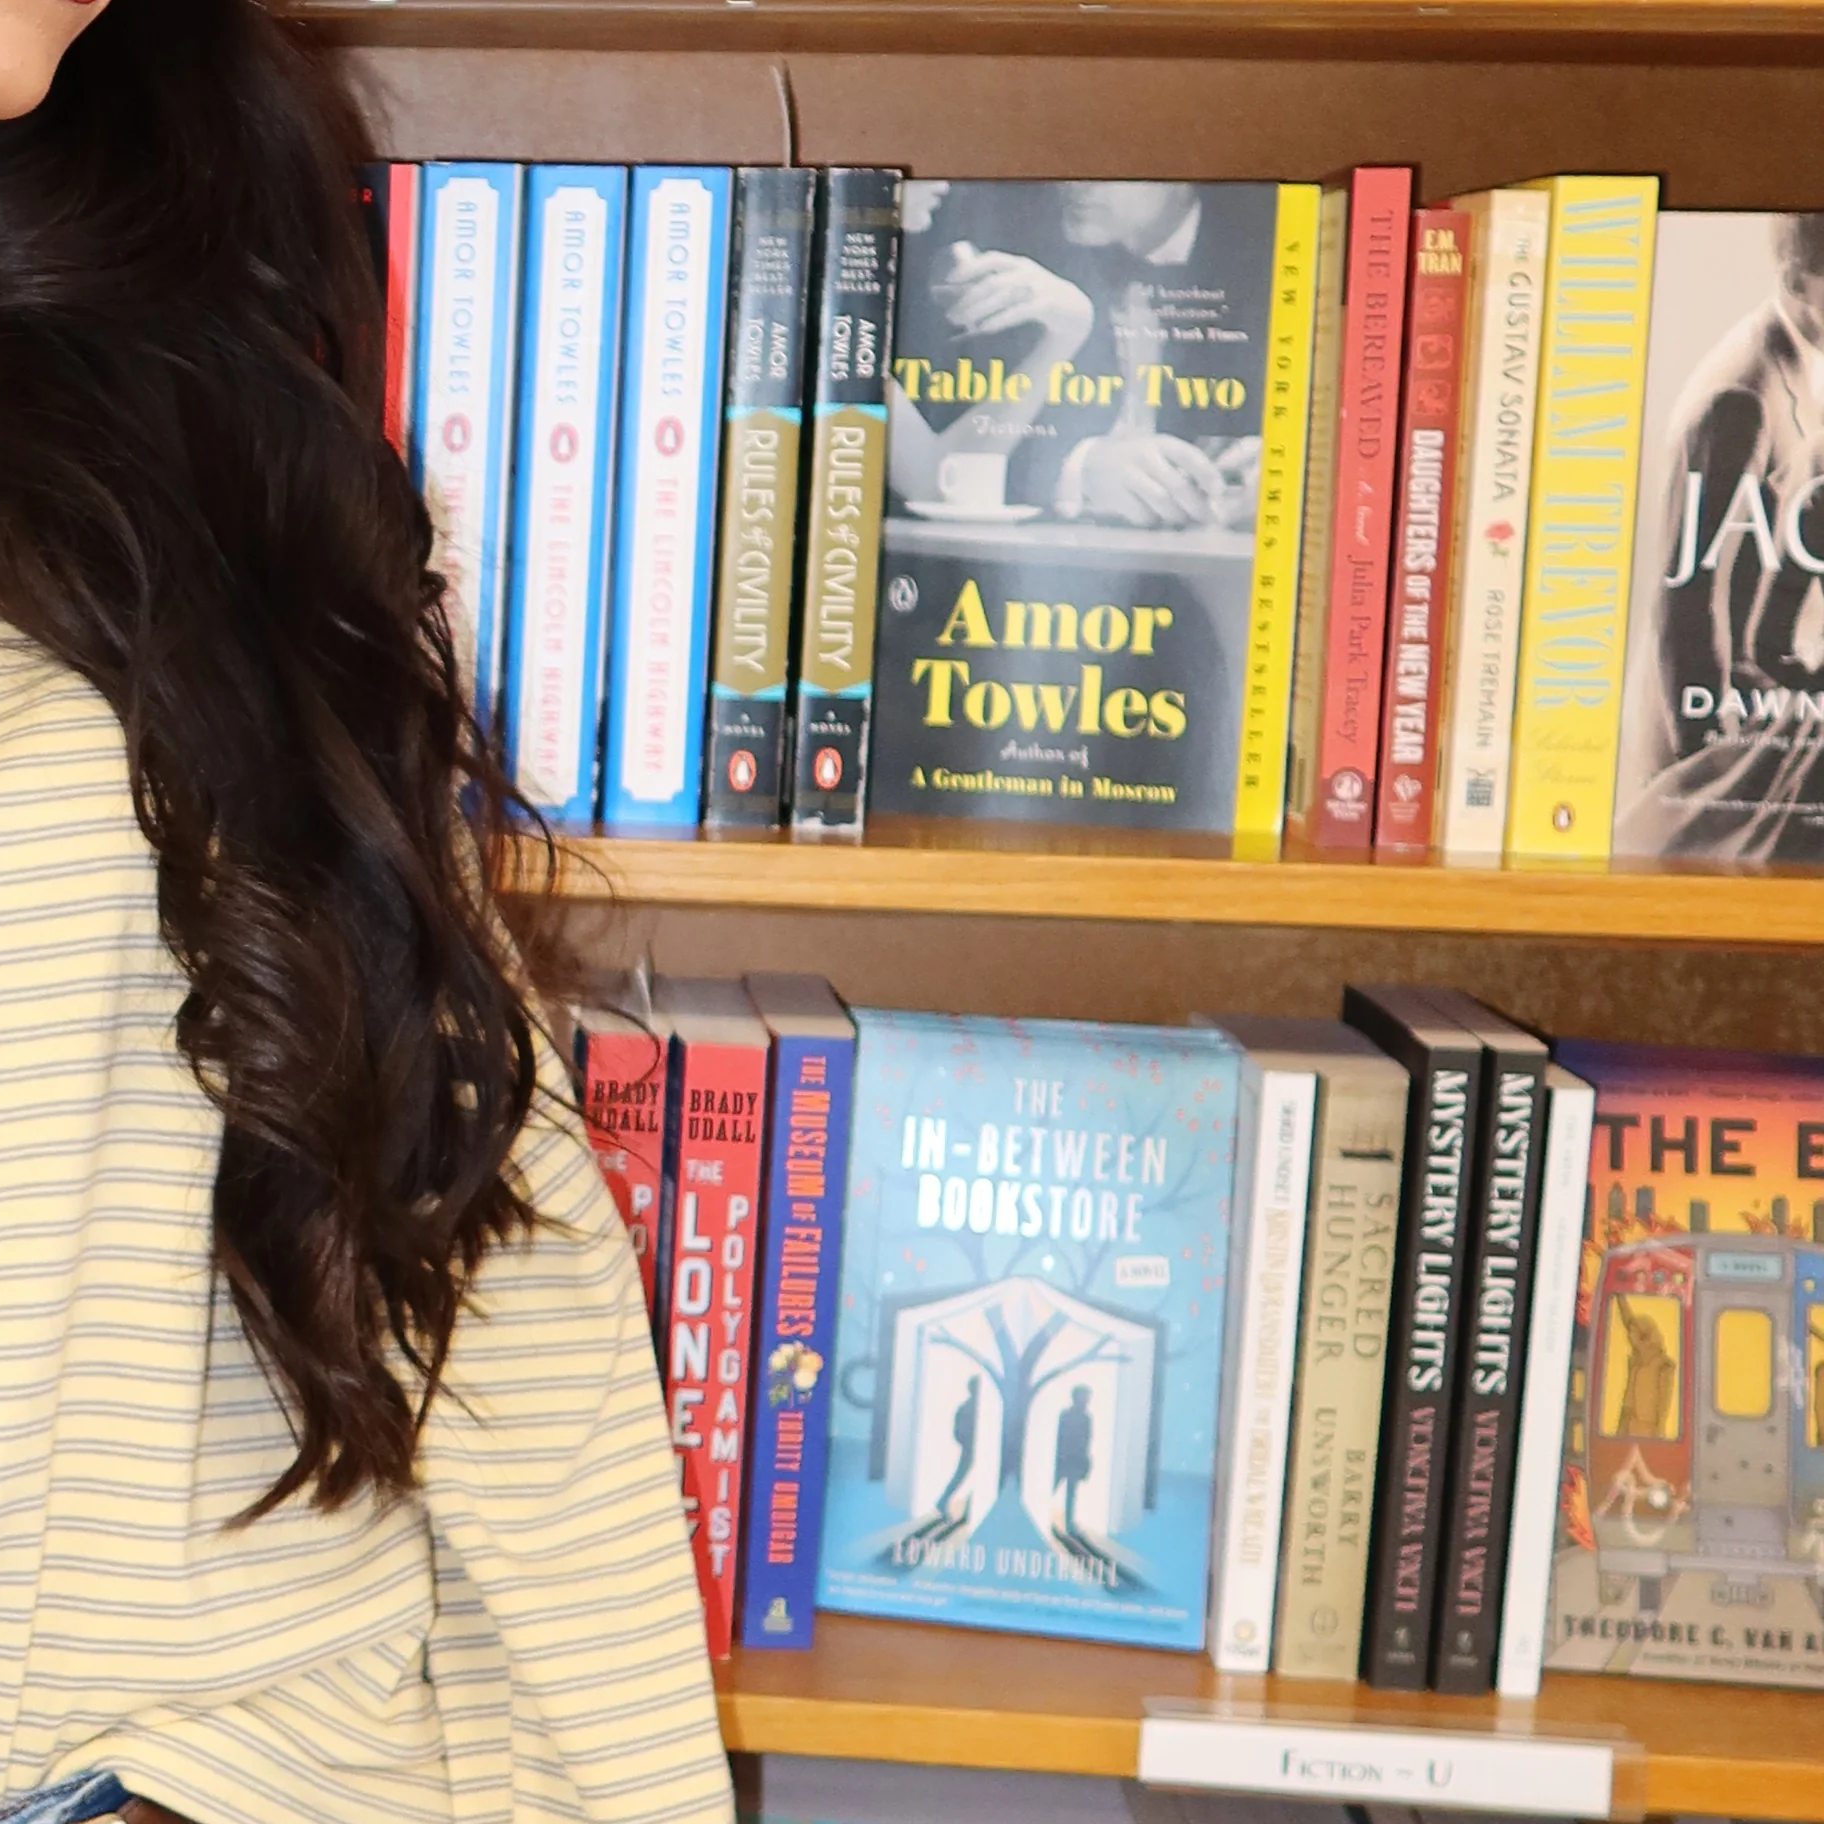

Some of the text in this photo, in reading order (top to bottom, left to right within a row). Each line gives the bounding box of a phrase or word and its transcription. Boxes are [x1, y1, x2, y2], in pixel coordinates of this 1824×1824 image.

[893, 355, 1247, 411] Table for Two
[1533, 194, 1644, 709] WILLIAM TREVOR
[937, 578, 1176, 656] Amor
[1391, 428, 1445, 763] DAUGHTERS OF THE NEW YEAR
[912, 658, 1187, 740] Towles
[910, 767, 1178, 804] A Gentleman in Moscow
[689, 1089, 758, 1113] BRADY
[799, 1054, 827, 1084] THE
[1014, 1079, 1063, 1117] THE
[687, 1117, 757, 1143] UDALL
[785, 1090, 828, 1197] MUSEUM
[1596, 1114, 1756, 1175] THE
[916, 1175, 1143, 1243] BOOKSTORE
[775, 1226, 822, 1339] FAILURES
[708, 1194, 750, 1577] POLYGAMIST
[767, 1482, 799, 1564] UMRIGAR
[1425, 1760, 1453, 1787] U
